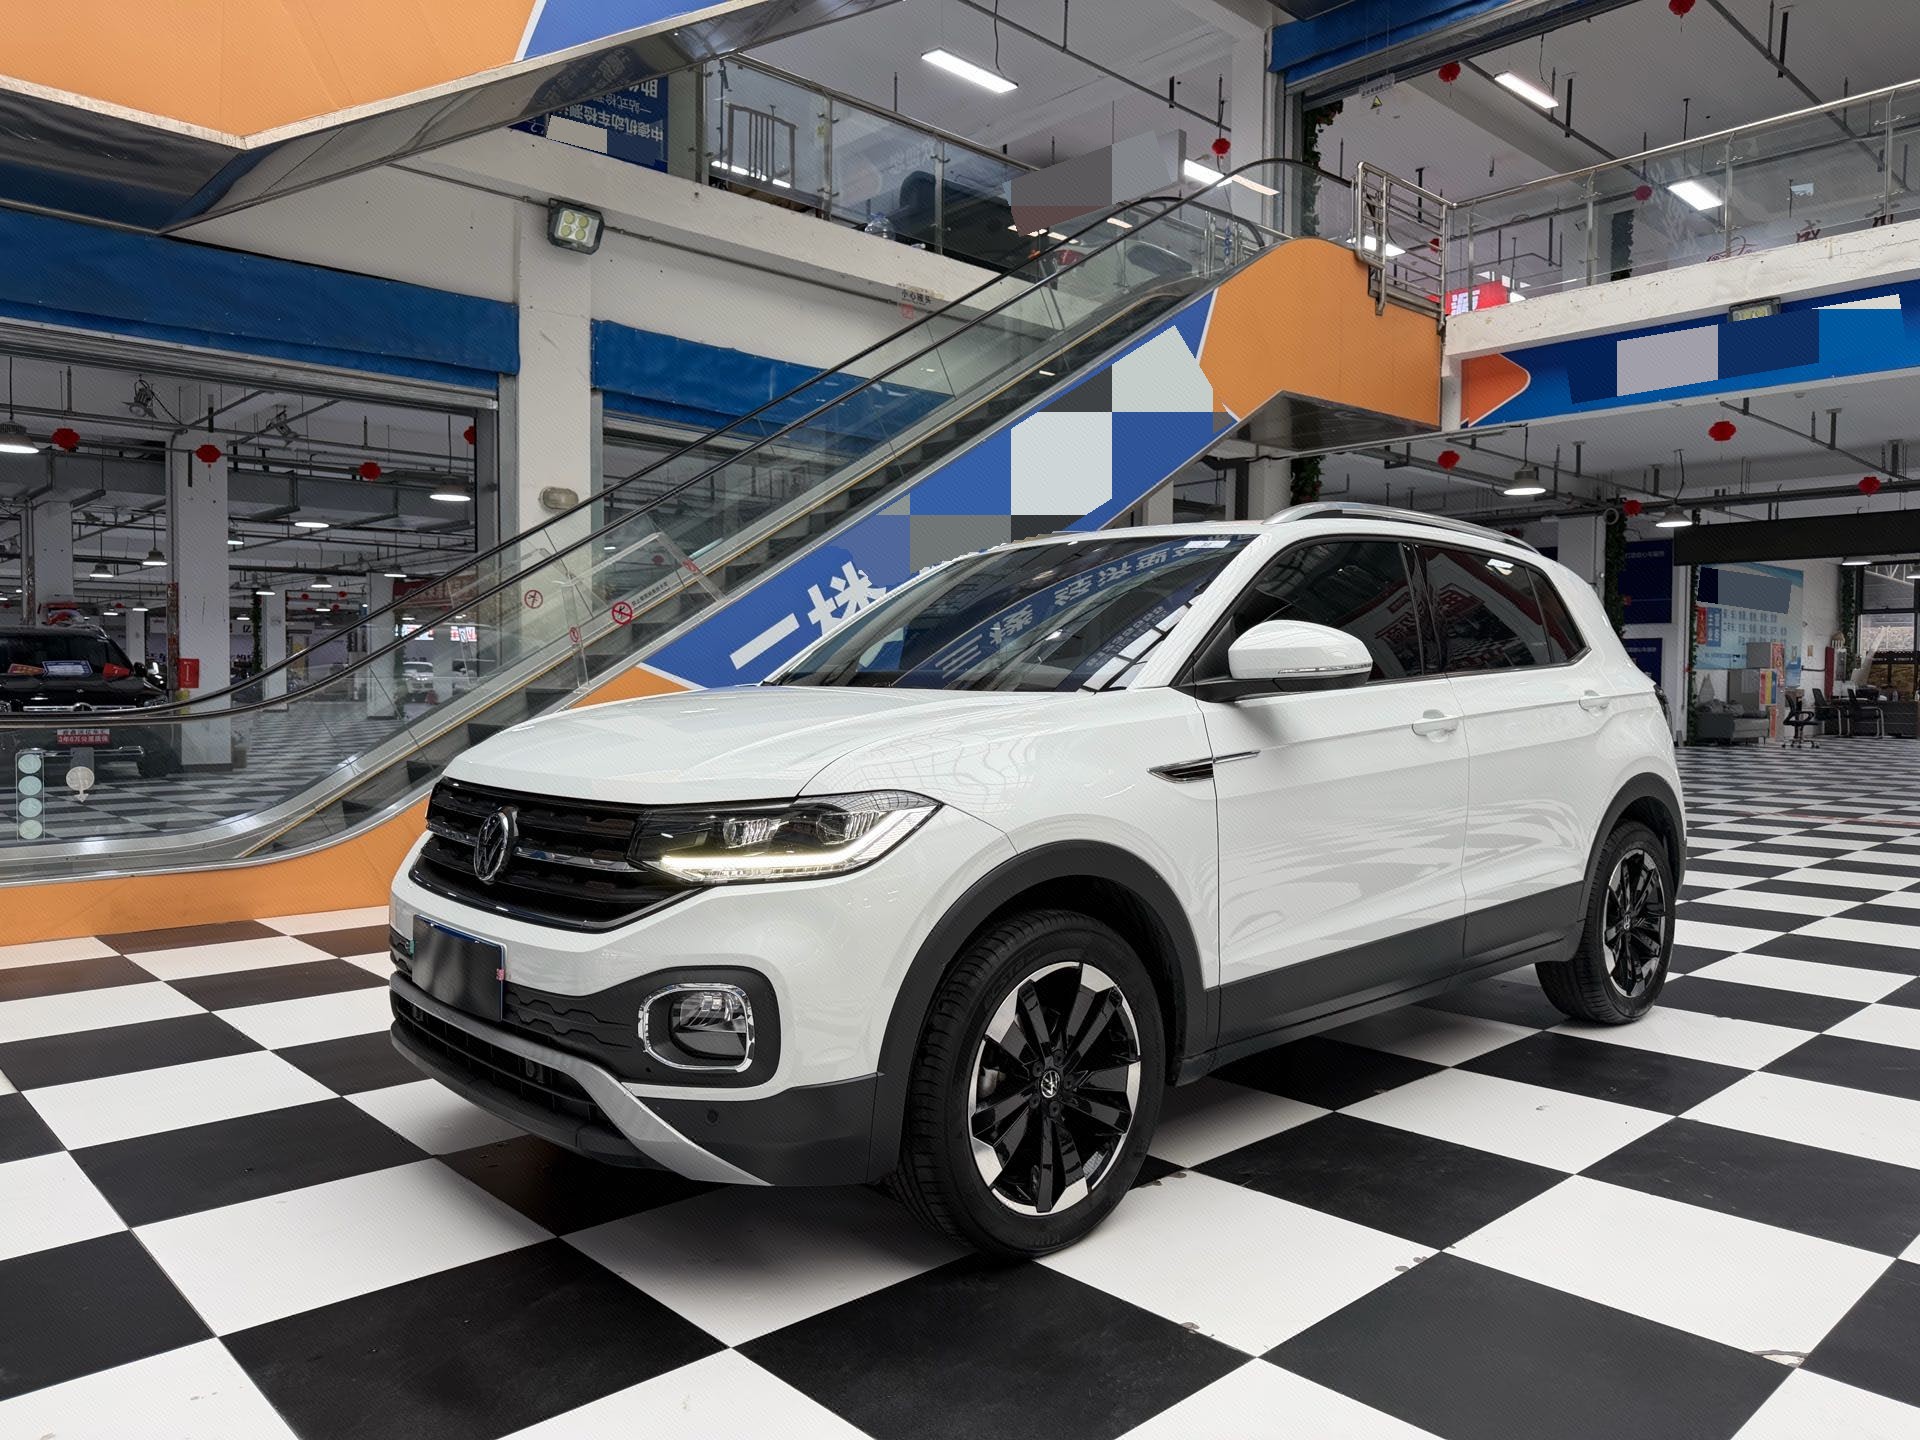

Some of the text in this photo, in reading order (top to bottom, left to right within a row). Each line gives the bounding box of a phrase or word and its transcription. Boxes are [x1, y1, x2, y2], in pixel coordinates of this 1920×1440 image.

[559, 104, 664, 142] 中德机动车检测
